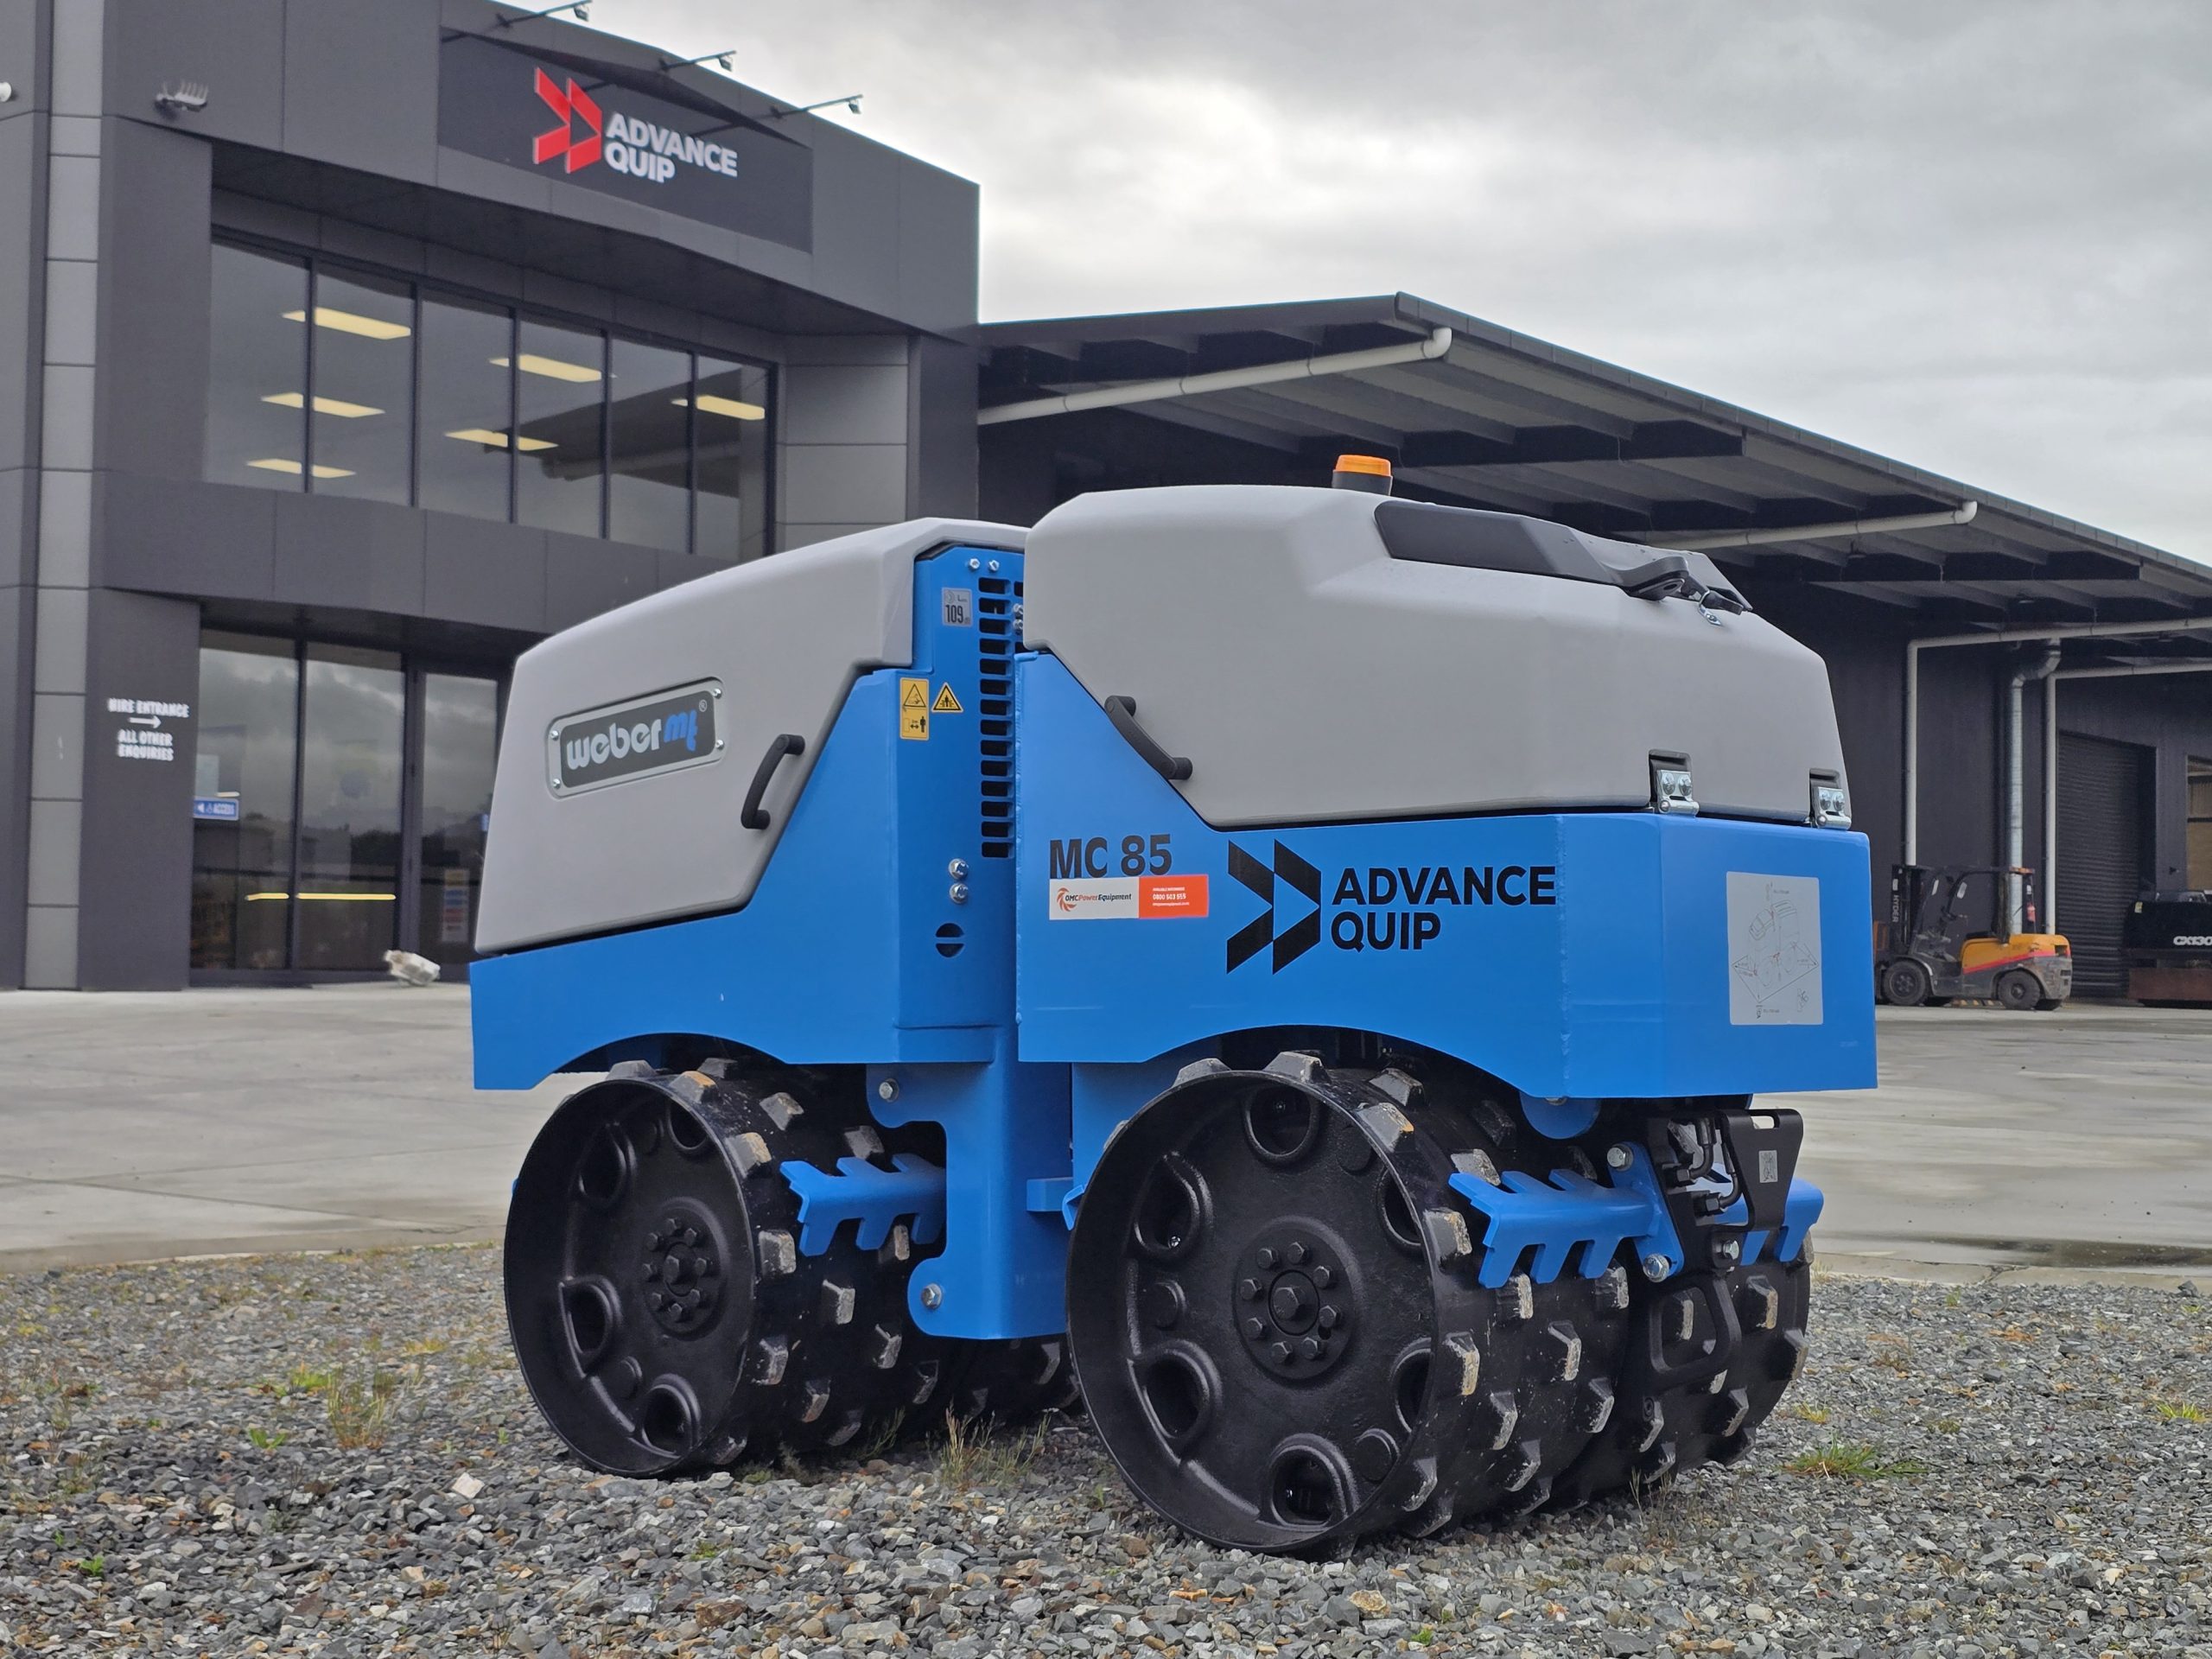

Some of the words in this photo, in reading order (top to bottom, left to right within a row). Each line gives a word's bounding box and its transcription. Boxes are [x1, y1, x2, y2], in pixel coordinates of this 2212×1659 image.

[605, 142, 676, 183] QUIP
[606, 111, 738, 177] ADVANCE
[945, 604, 963, 623] 109
[108, 697, 135, 713] HIRE
[136, 699, 189, 718] ENTRANCE
[118, 728, 138, 744] ALL
[138, 730, 174, 747] OTHER
[118, 743, 175, 761] ENQUIRIES
[1050, 836, 1108, 880] MC
[1121, 834, 1173, 877] 85
[1332, 865, 1556, 906] ADVANCE
[1331, 911, 1441, 953] QUIP
